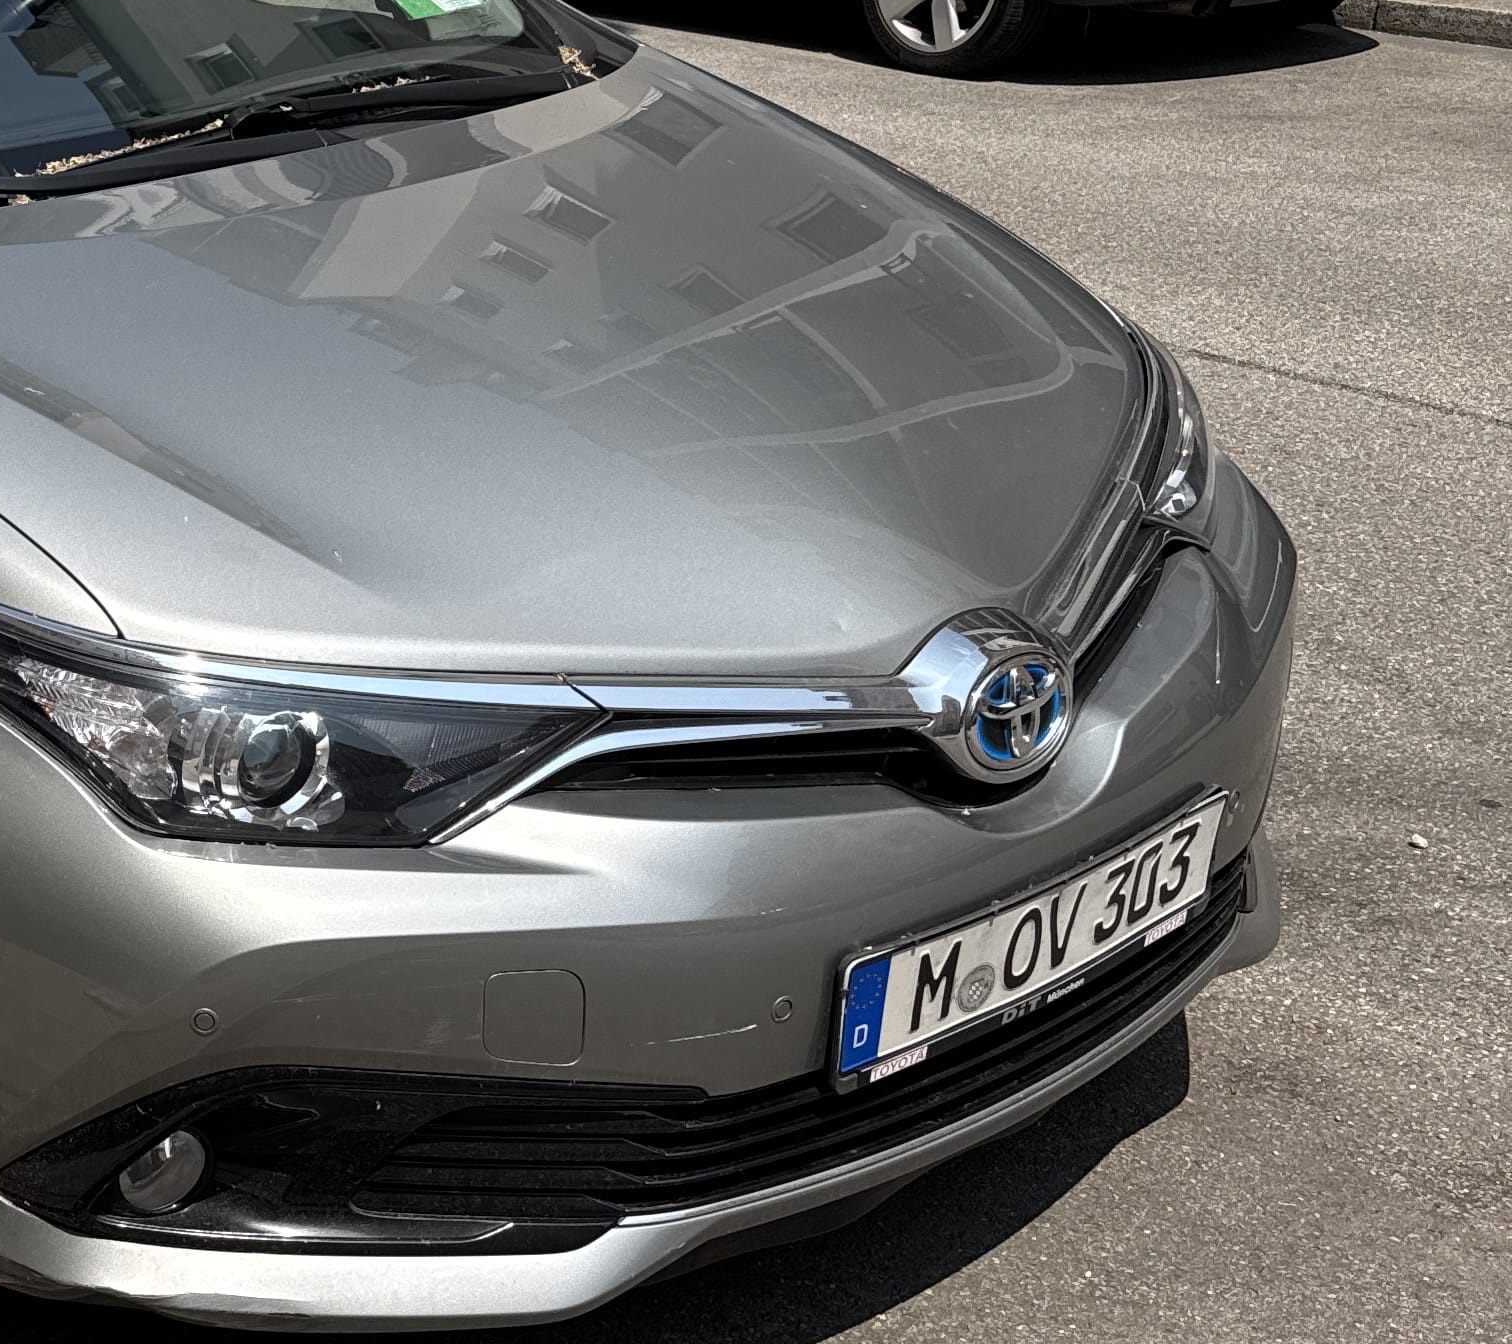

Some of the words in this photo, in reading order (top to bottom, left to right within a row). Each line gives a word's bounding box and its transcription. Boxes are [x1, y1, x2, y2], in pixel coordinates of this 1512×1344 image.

[908, 938, 962, 1034] M
[1002, 881, 1088, 991] OV
[1092, 818, 1203, 944] 303
[1147, 911, 1186, 944] TOYOTA
[1046, 977, 1086, 1004] München
[853, 1023, 868, 1049] D
[872, 1046, 925, 1080] TOYOTA
